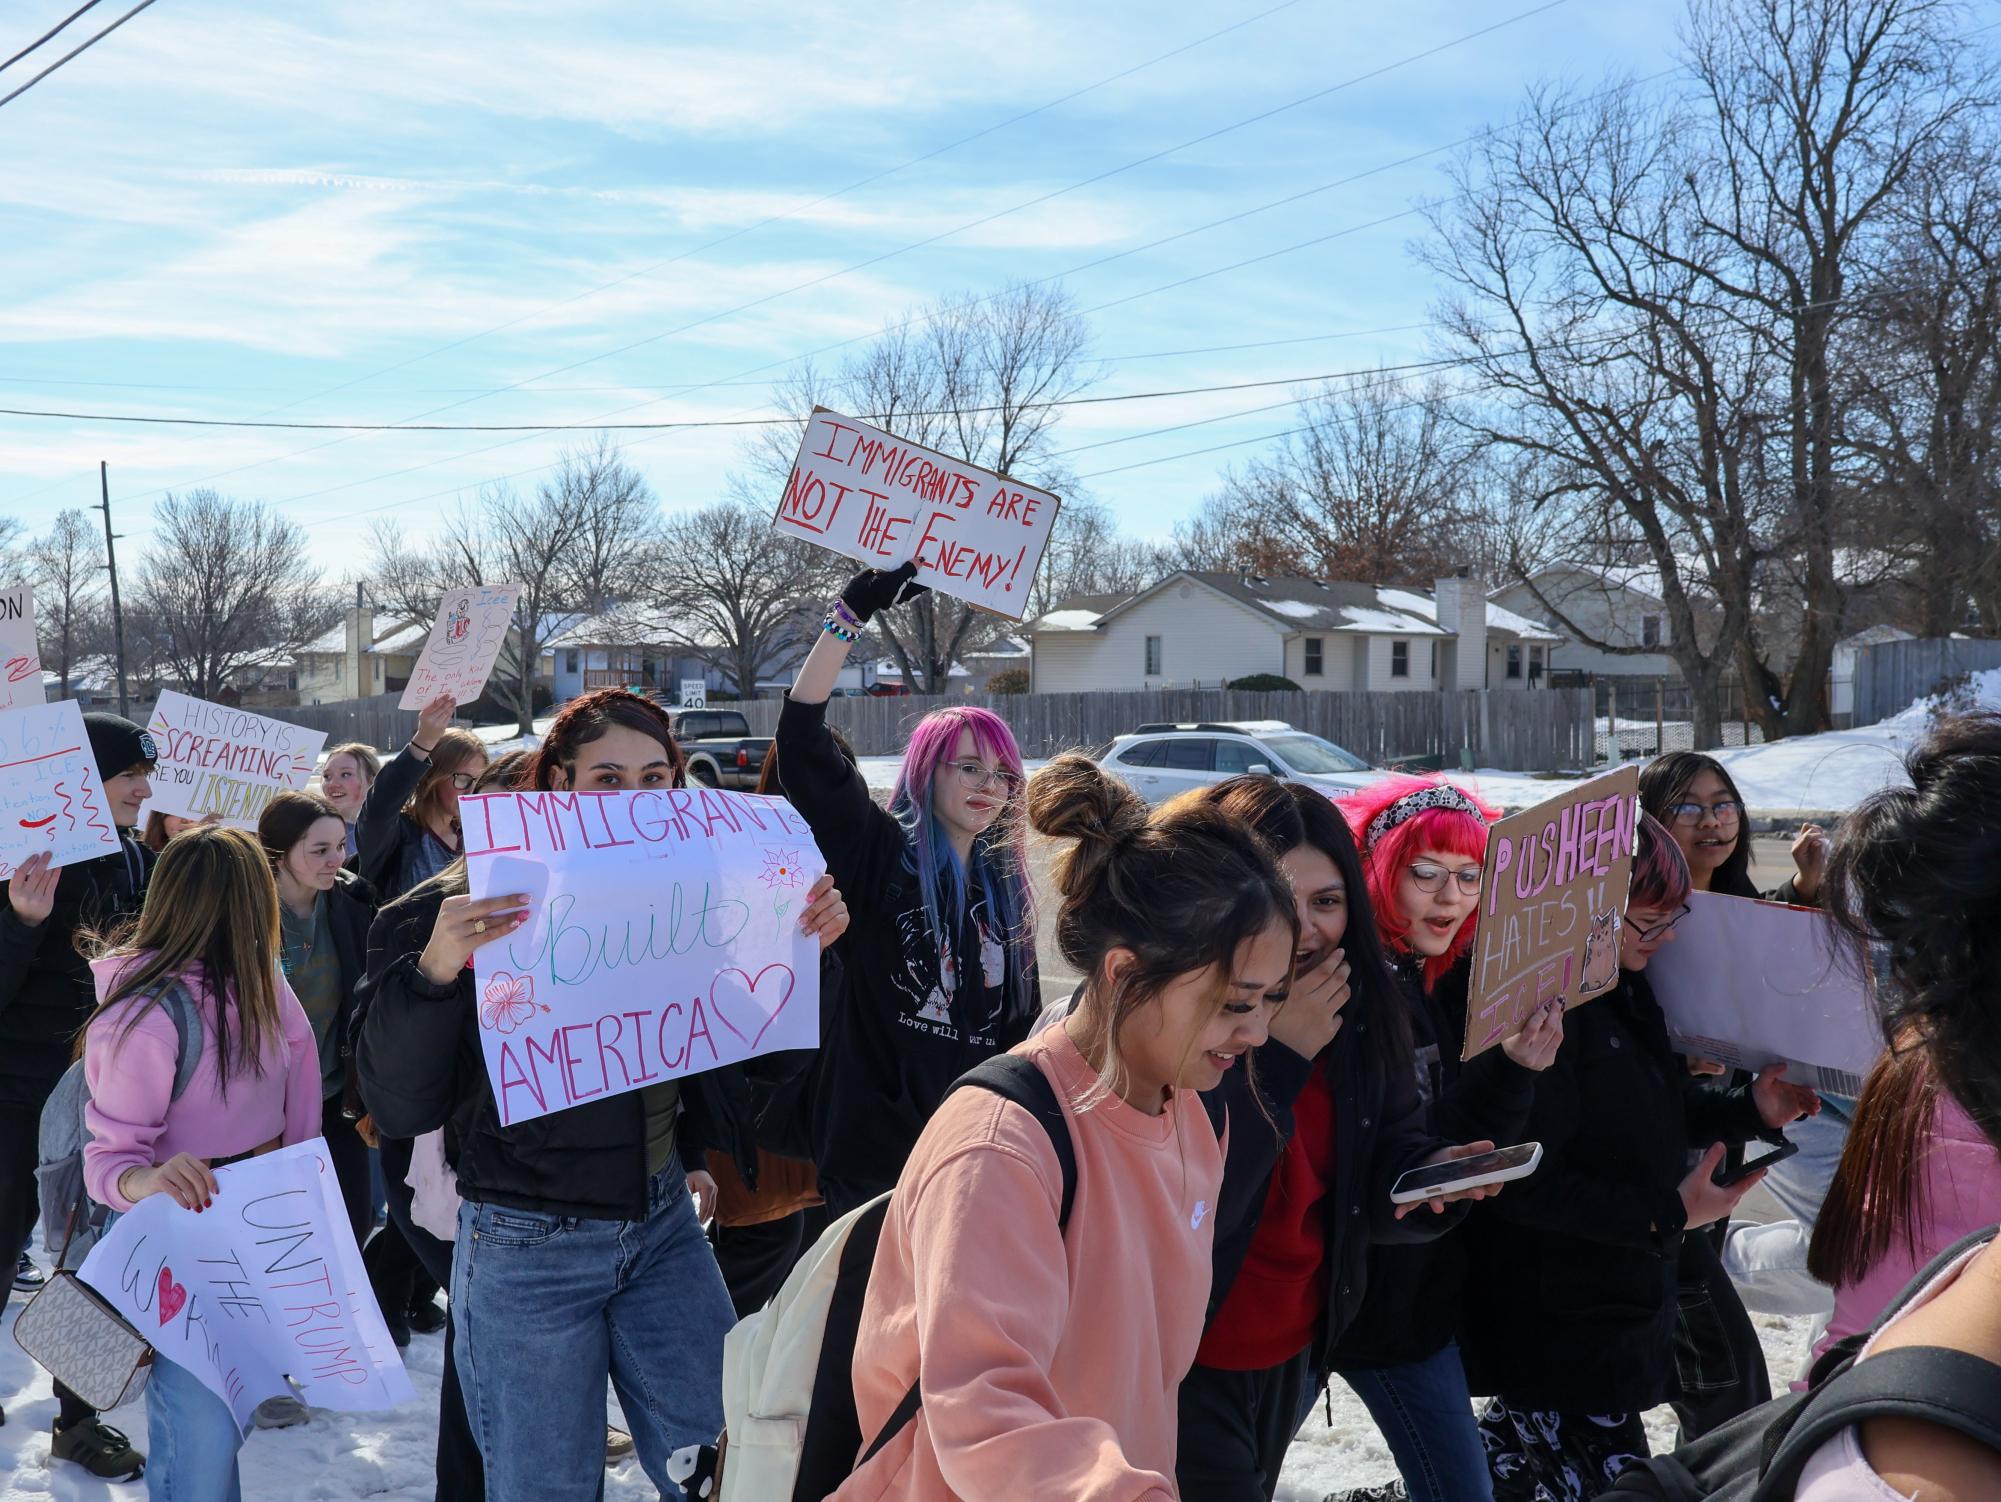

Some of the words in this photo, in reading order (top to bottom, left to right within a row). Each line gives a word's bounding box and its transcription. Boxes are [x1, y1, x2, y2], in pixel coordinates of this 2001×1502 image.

[811, 420, 980, 509] IMMIGRANTS
[987, 488, 1041, 526] ARE
[783, 467, 854, 531] NOT
[858, 489, 912, 555] THE
[914, 512, 1026, 592] ENEMY!
[416, 668, 437, 682] The
[684, 698, 704, 709] 40
[158, 728, 291, 780] SCREAMING
[183, 703, 273, 743] HISTORY
[274, 726, 295, 751] IS
[149, 764, 169, 782] RE
[174, 767, 194, 785] YOU
[187, 771, 281, 821] LISTENIN
[459, 789, 812, 857] IMMIGRANTS
[1489, 794, 1637, 917] PUSHEEN
[509, 881, 749, 985] Built
[1480, 890, 1577, 994] HATES
[499, 997, 718, 1125] AMERICA
[898, 1011, 928, 1032] Love
[932, 1026, 959, 1041] will
[198, 1248, 270, 1324] THE
[242, 1190, 368, 1385] UNTRUMP
